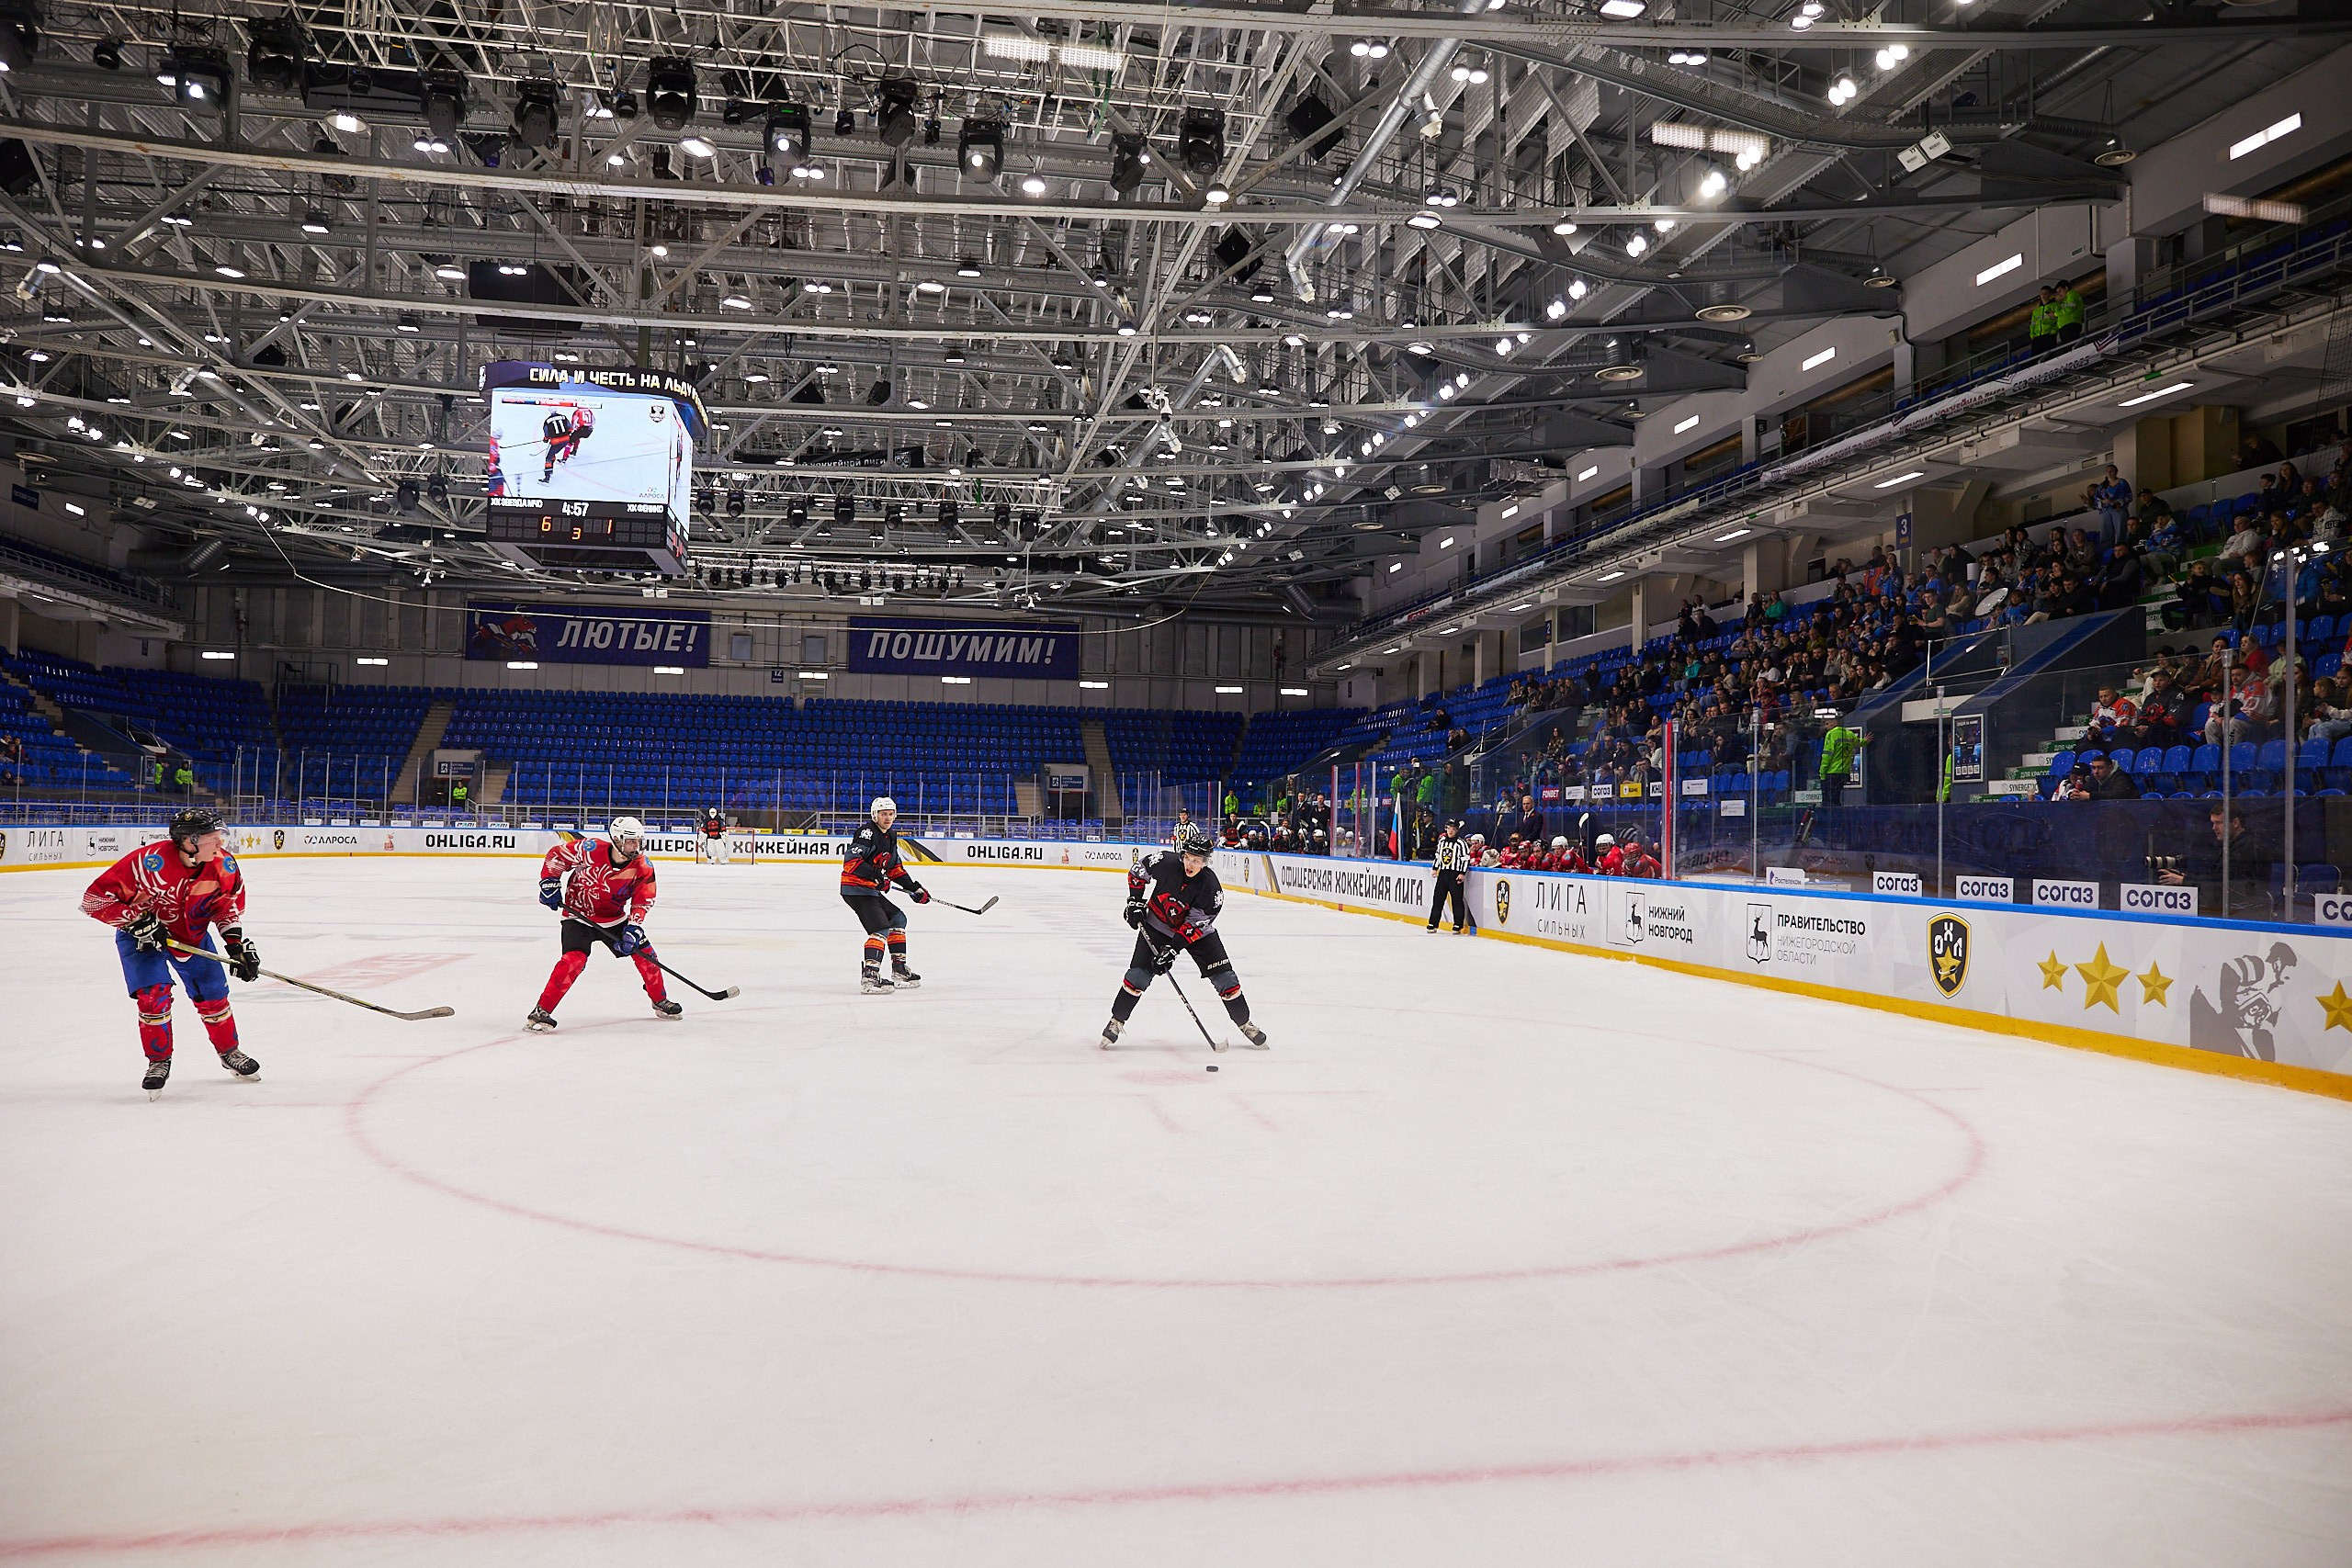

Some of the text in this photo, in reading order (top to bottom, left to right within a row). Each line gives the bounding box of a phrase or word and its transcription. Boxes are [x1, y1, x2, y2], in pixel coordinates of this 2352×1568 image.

[529, 367, 692, 398] СИЛА И ЧЕСТЬ НА ЛЬДУ
[552, 419, 566, 434] 11
[561, 501, 589, 517] 4:57
[541, 515, 551, 532] 6
[606, 519, 613, 534] 1
[1901, 518, 1907, 536] 3
[571, 527, 582, 540] 3
[556, 620, 698, 653] ЛЮТЫЕ!
[867, 632, 1057, 664] ПОШУМИМ!
[1542, 788, 1559, 799] FONBET
[27, 830, 64, 848] ЛИГА
[425, 834, 515, 849] OHLIGA.RU
[98, 844, 119, 852] НОВГОРОД
[967, 845, 1043, 861] OHLIGA.RU
[28, 852, 63, 862] СИЛЬНЫХ
[1131, 863, 1147, 876] 24
[1281, 865, 1423, 907] ОФИЦЕРСКАЯ ХОККЕЙНАЯ ЛИГА
[1774, 876, 1802, 886] Ростелеком
[1535, 881, 1587, 914] ЛИГА
[1648, 906, 1685, 921] НИЖНИЙ
[1537, 919, 1586, 939] СИЛЬНЫХ
[1777, 914, 1866, 936] ПРАВИТЕЛЬСТВО
[1648, 924, 1693, 943] НОВГОРОД
[1777, 935, 1856, 955] НИЖЕГОРОДСКОЙ
[1777, 950, 1816, 965] ОБЛАСТИ
